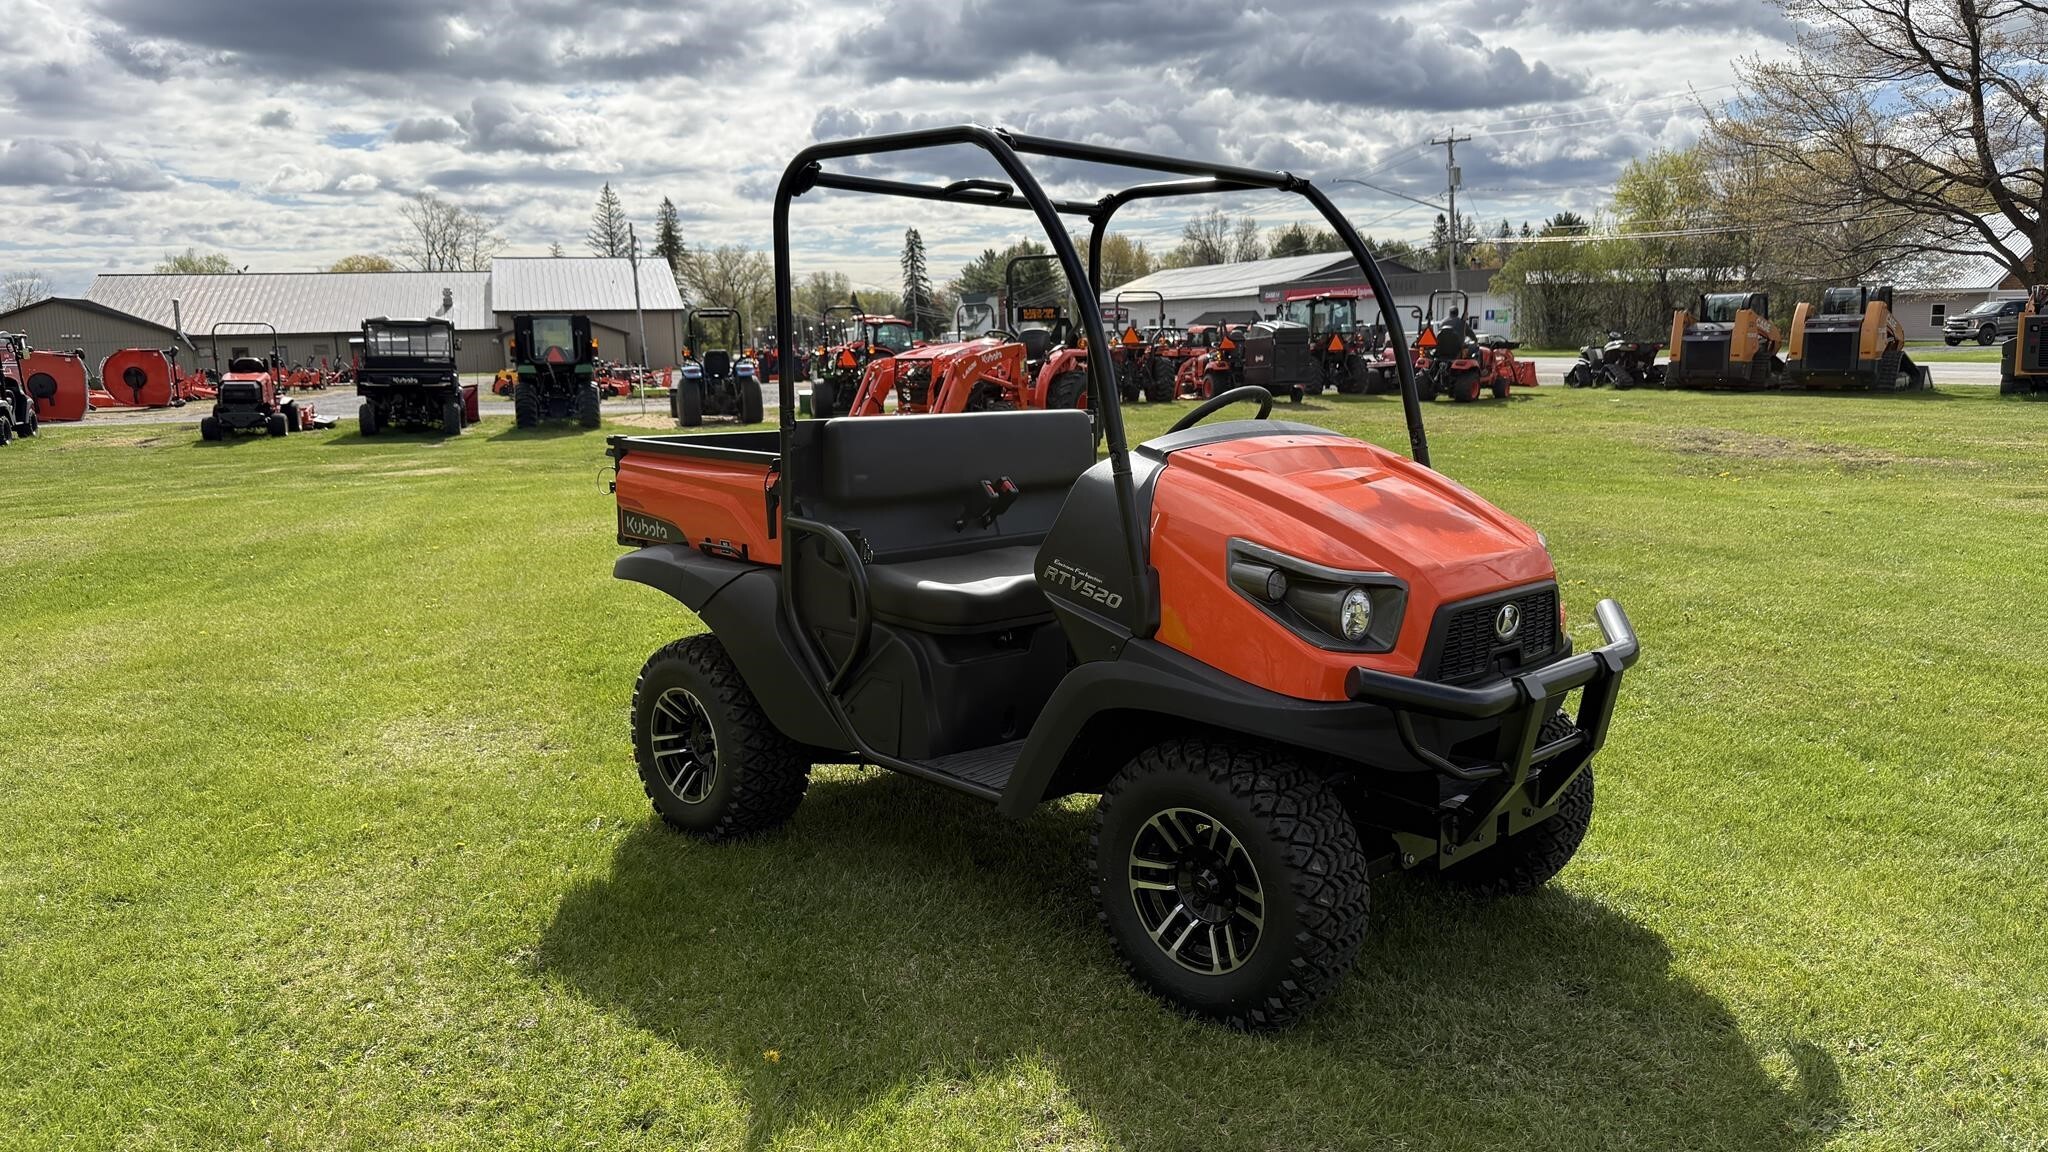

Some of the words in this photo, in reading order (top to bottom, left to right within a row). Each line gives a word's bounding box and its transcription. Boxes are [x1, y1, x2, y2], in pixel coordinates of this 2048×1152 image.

[981, 350, 1003, 364] Kubota
[392, 376, 419, 385] Kubota
[626, 515, 668, 539] Kubota
[1043, 564, 1123, 609] RTV520
